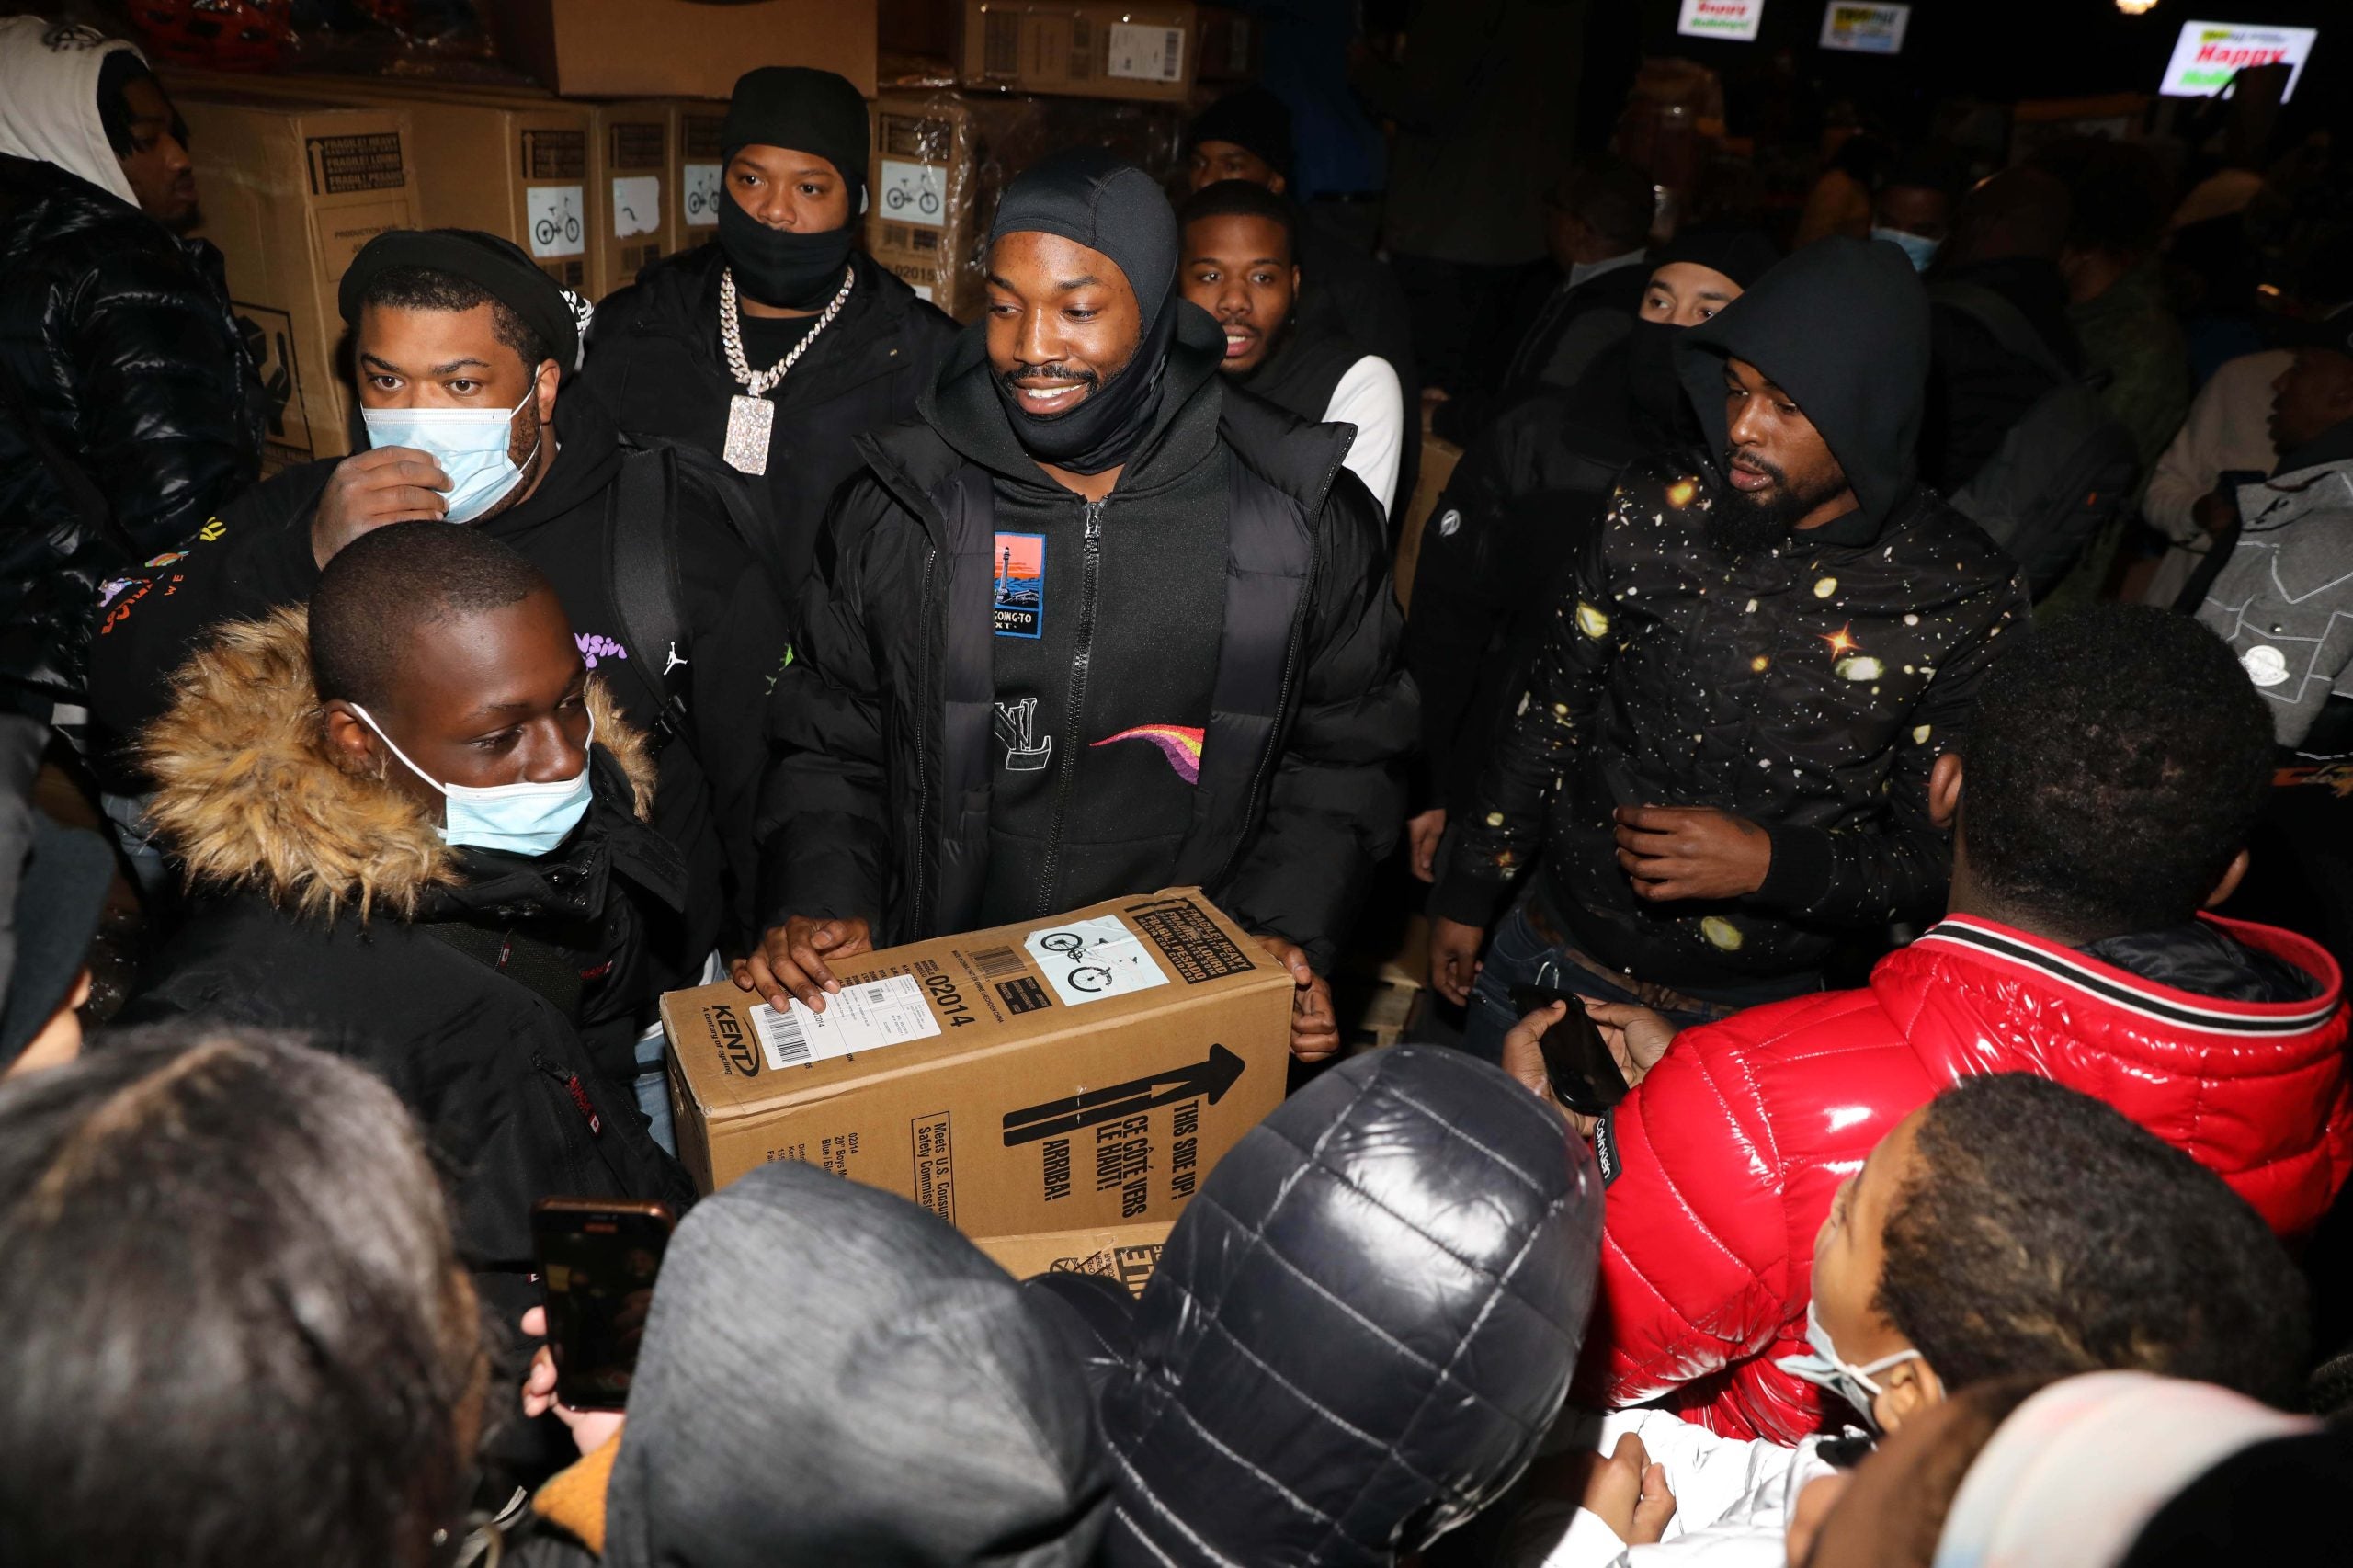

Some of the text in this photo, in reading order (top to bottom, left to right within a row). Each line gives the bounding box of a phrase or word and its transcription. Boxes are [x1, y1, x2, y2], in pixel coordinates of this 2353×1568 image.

[2196, 44, 2288, 68] Happy
[1143, 915, 1208, 979] FRAGIL! PESADO
[1155, 937, 1170, 949] CON
[1168, 952, 1196, 982] CUIDADO
[1185, 908, 1250, 967] FRAGILE! HEAVY
[1186, 942, 1203, 959] AVEC
[1200, 960, 1218, 975] SOIN
[1196, 945, 1229, 973] LOURD
[1218, 951, 1239, 970] CARE
[925, 974, 976, 1028] 02014
[704, 1013, 719, 1040] century
[718, 1050, 733, 1075] cycling
[711, 1005, 753, 1067] KENT
[822, 1139, 832, 1156] Blue
[835, 1149, 846, 1171] Boys
[848, 1132, 858, 1155] 02014
[918, 1126, 932, 1158] Safety
[1096, 1121, 1123, 1192] LE HAUT!
[1122, 1115, 1154, 1219] CE CÔTÉ VERS
[1171, 1099, 1199, 1201] THIS SIDE UP!
[934, 1122, 950, 1221] Meets U.S. Consum
[1042, 1138, 1071, 1202] ARRIBA!
